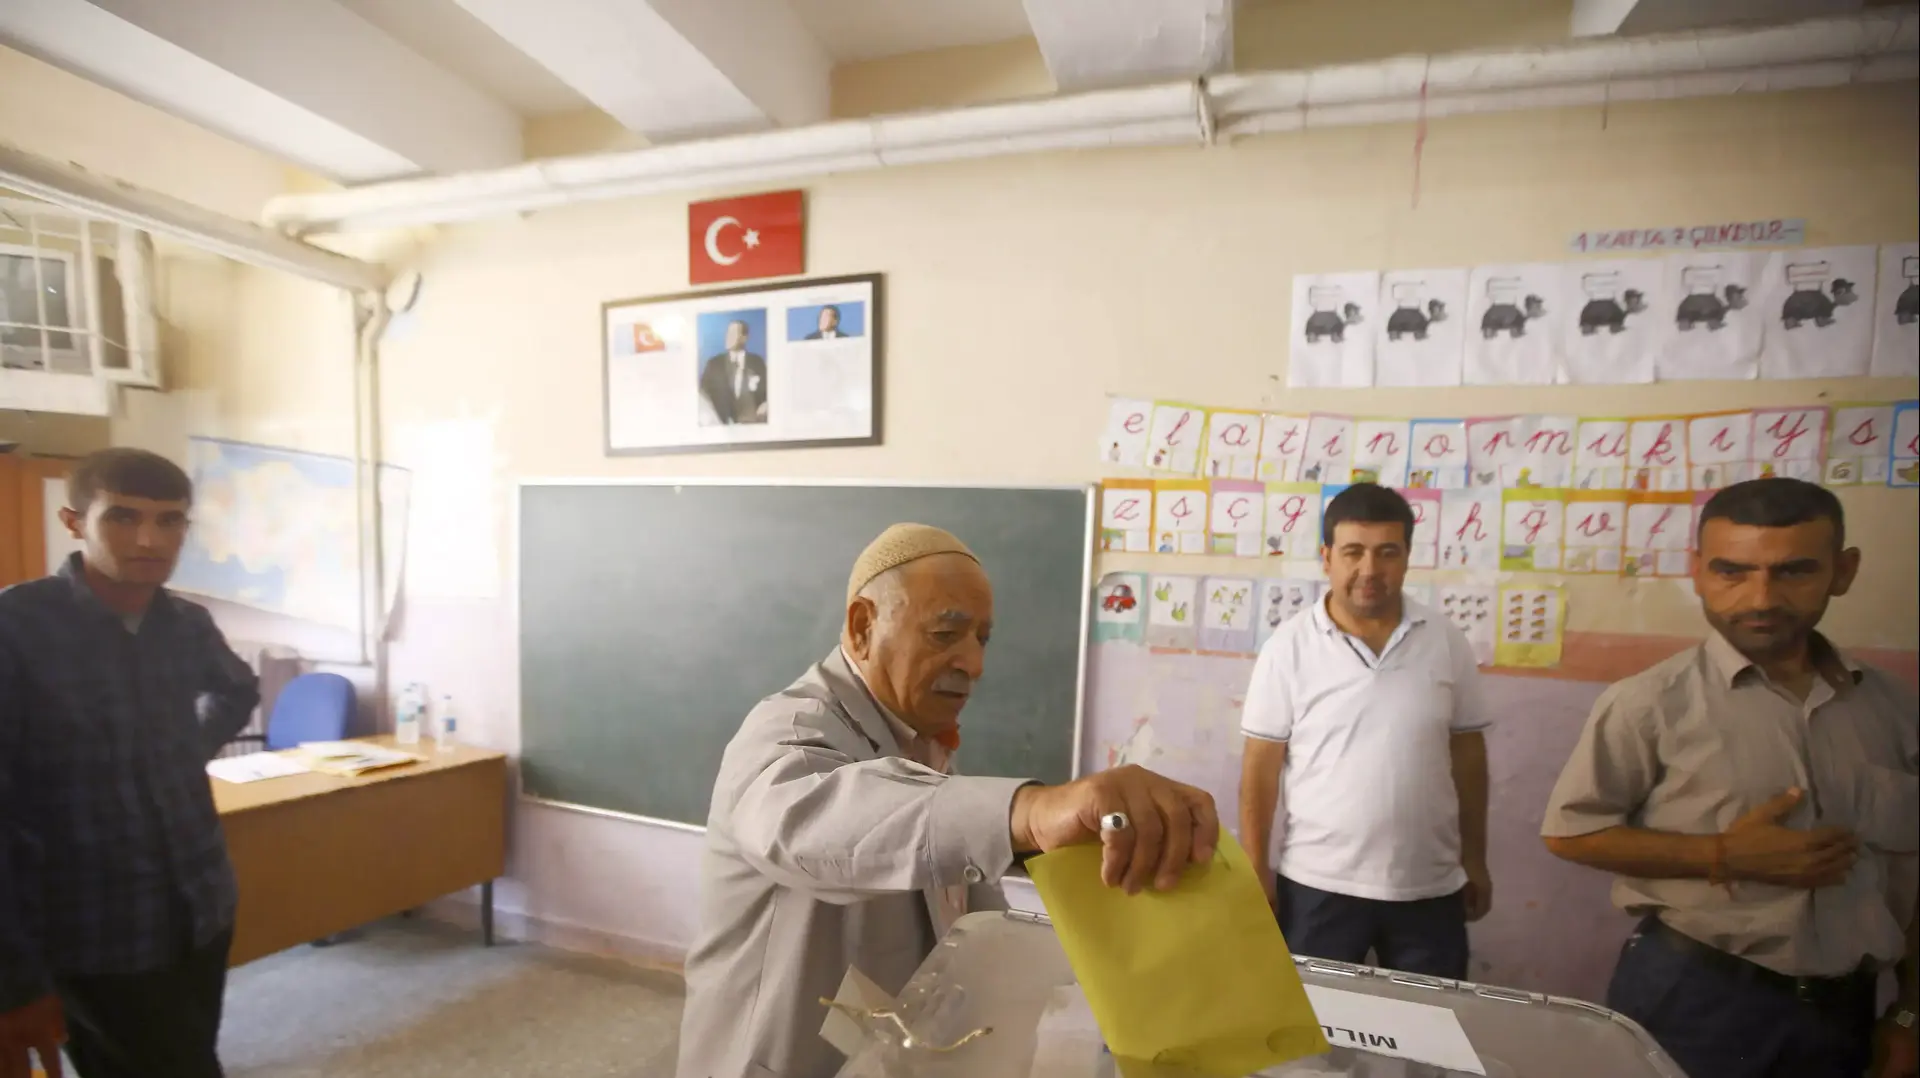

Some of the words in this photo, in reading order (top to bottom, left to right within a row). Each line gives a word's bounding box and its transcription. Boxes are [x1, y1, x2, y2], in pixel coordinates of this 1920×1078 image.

[1123, 411, 1145, 434] e
[1219, 422, 1252, 448] a
[1277, 423, 1299, 455] t
[1321, 427, 1345, 459] i
[1365, 430, 1400, 457] n
[1423, 432, 1455, 458] o
[1524, 428, 1573, 456] m
[1586, 432, 1628, 458] u
[1642, 422, 1676, 467] k
[1766, 412, 1810, 458] y
[1848, 417, 1880, 446] s
[1113, 498, 1141, 522] z
[1279, 495, 1307, 533] g
[1455, 501, 1488, 542] h
